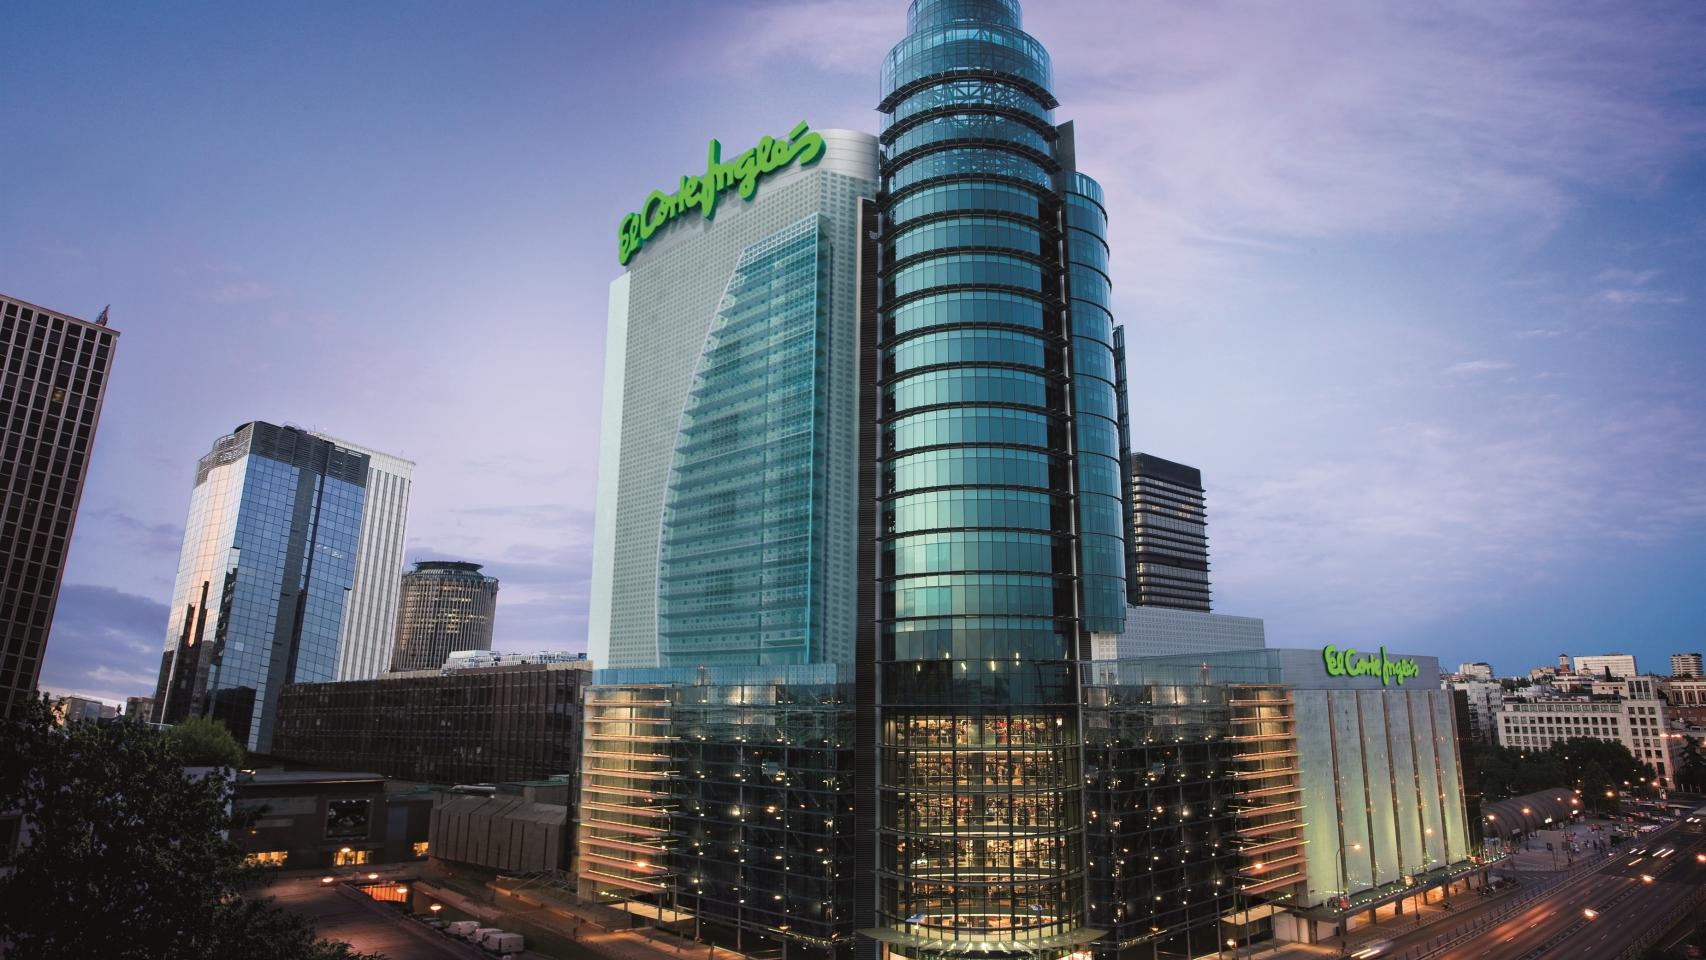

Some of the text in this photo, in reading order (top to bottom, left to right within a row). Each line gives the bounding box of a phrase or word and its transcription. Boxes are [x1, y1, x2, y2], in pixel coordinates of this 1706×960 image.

[618, 119, 826, 266] El Corte Inglés
[1323, 644, 1419, 686] El Corte Inglés
